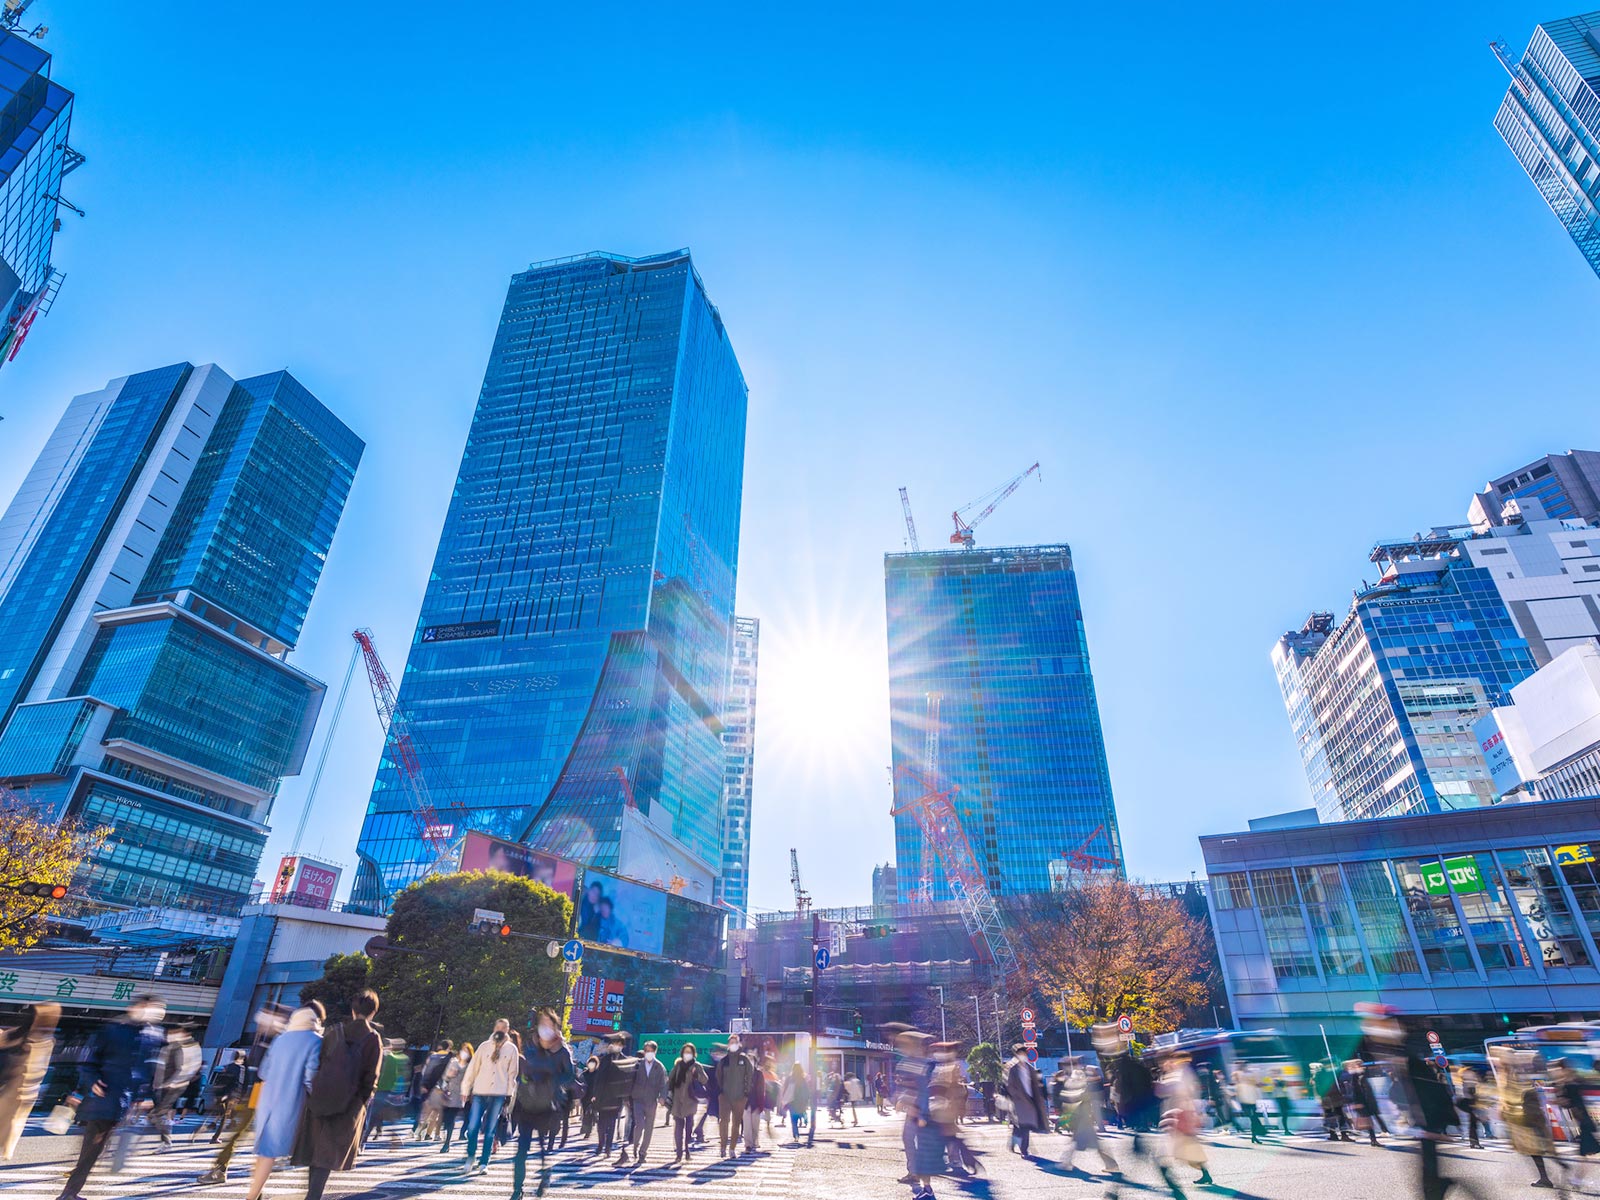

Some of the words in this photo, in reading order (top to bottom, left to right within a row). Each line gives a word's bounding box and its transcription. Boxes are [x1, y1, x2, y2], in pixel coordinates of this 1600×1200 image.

[115, 795, 142, 808] Hikarie
[301, 868, 334, 886] ほけんの
[0, 971, 136, 1000] 渋谷駅
